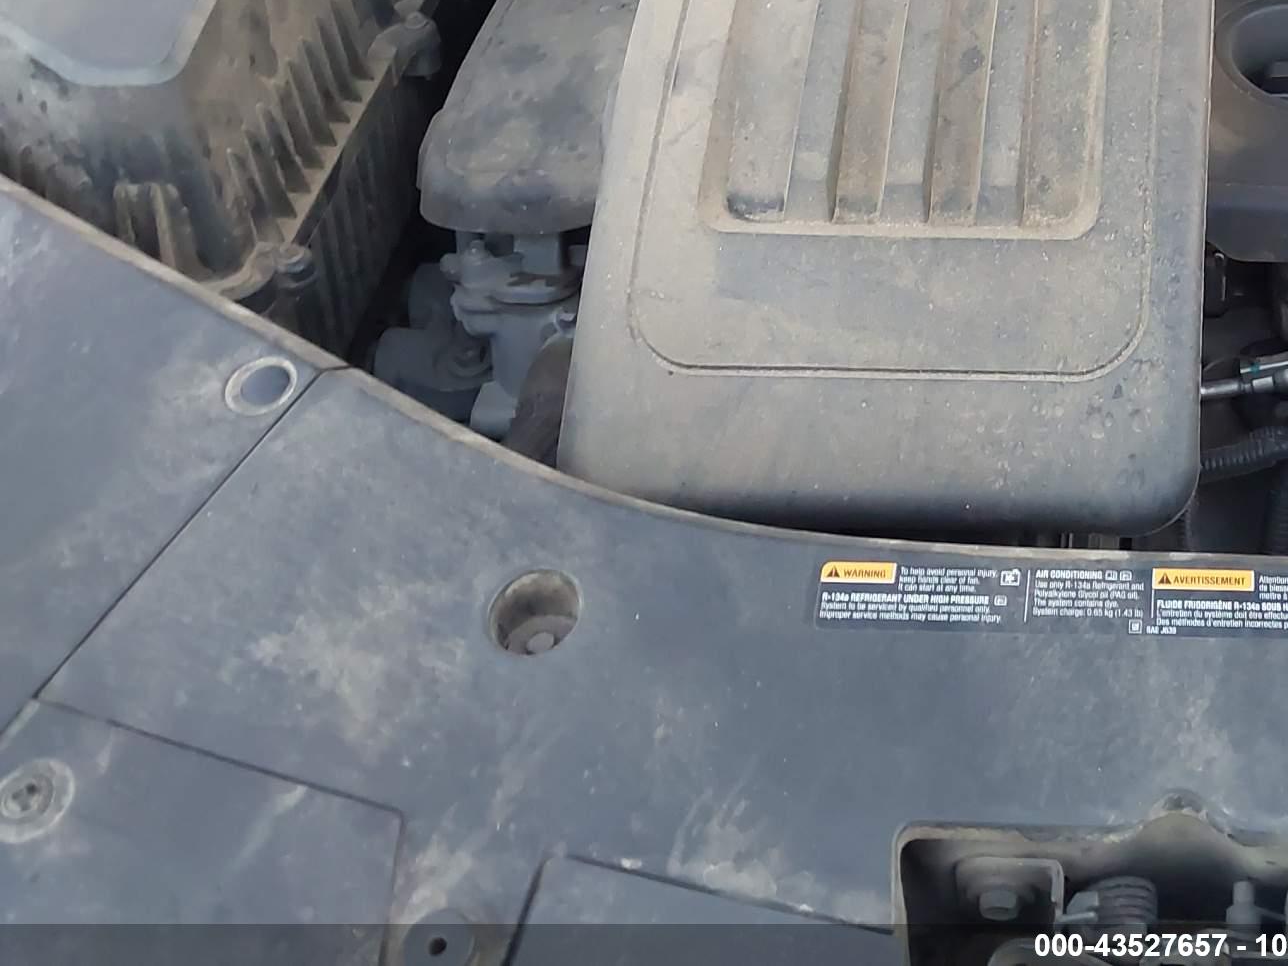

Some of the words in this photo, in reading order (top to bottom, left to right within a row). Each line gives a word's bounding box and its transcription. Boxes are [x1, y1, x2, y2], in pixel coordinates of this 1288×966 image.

[843, 569, 886, 579] WARNING
[901, 566, 909, 576] To
[910, 566, 925, 578] help
[926, 567, 946, 576] avoid
[946, 567, 976, 579] personal
[1035, 570, 1049, 579] AIR
[1050, 570, 1103, 580] CONDITIONING
[899, 575, 917, 585] keep
[917, 576, 939, 584] hands
[940, 576, 958, 584] clear
[1173, 575, 1246, 586] AVERTISSEMENT
[919, 584, 935, 592] start
[944, 586, 958, 594] any
[1035, 580, 1048, 588] Use
[1049, 580, 1064, 591] only
[1065, 580, 1091, 589] R-134a
[1092, 581, 1130, 592] Refrigerant
[1131, 582, 1144, 591] and
[1259, 584, 1268, 592] de
[850, 593, 903, 603] REFRIGERANT
[903, 594, 929, 604] UNDER
[930, 594, 950, 604] HIGH
[950, 595, 990, 605] PRESSURE
[1034, 589, 1077, 601] Polyalkylene
[1078, 590, 1099, 601] Glycol
[1099, 590, 1109, 599] oil
[821, 602, 847, 613] System
[848, 603, 856, 611] to
[857, 603, 866, 611] be
[867, 603, 897, 611] serviced
[898, 604, 908, 613] by
[908, 604, 939, 614] qualified
[939, 604, 974, 614] personnel
[1034, 598, 1047, 607] The
[1048, 598, 1073, 609] system
[1074, 599, 1104, 608] contains
[1156, 600, 1183, 610] FLUIDE
[1184, 600, 1233, 611] FRIGORIGÈNE
[1261, 602, 1282, 612] SOUS
[819, 610, 852, 621] Improper
[852, 611, 878, 620] service
[879, 612, 910, 620] methods
[910, 614, 926, 622] may
[949, 613, 980, 623] personal
[1033, 608, 1058, 618] System
[1104, 608, 1114, 619] kg
[1194, 610, 1203, 618] du
[1234, 611, 1247, 619] doit
[1156, 618, 1170, 626] Des
[1244, 620, 1282, 629] incorrectes
